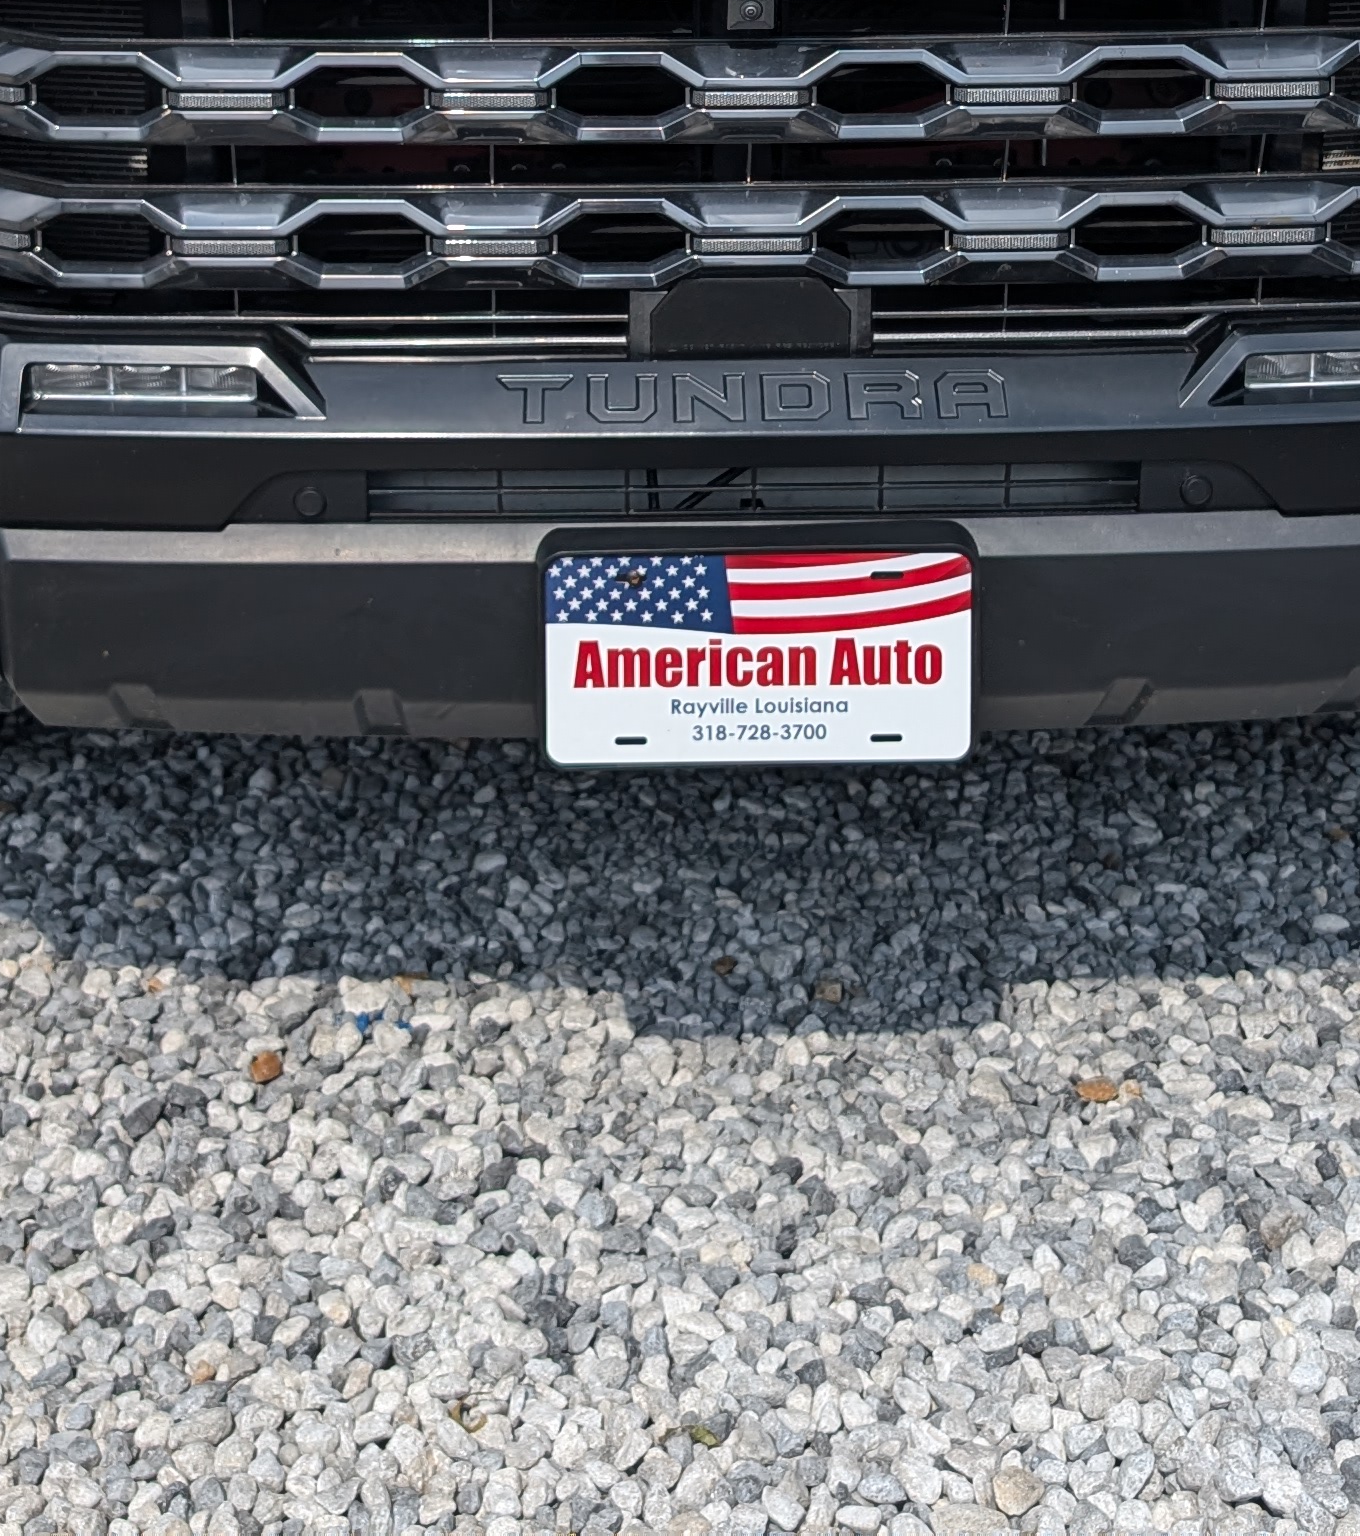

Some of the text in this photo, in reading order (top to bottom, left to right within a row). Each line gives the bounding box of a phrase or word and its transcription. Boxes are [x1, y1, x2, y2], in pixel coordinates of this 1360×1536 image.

[496, 370, 1010, 424] TUNDRA
[572, 637, 944, 689] American Auto
[670, 697, 848, 718] Rayville Louisiana
[692, 723, 827, 741] 318-728-3700
